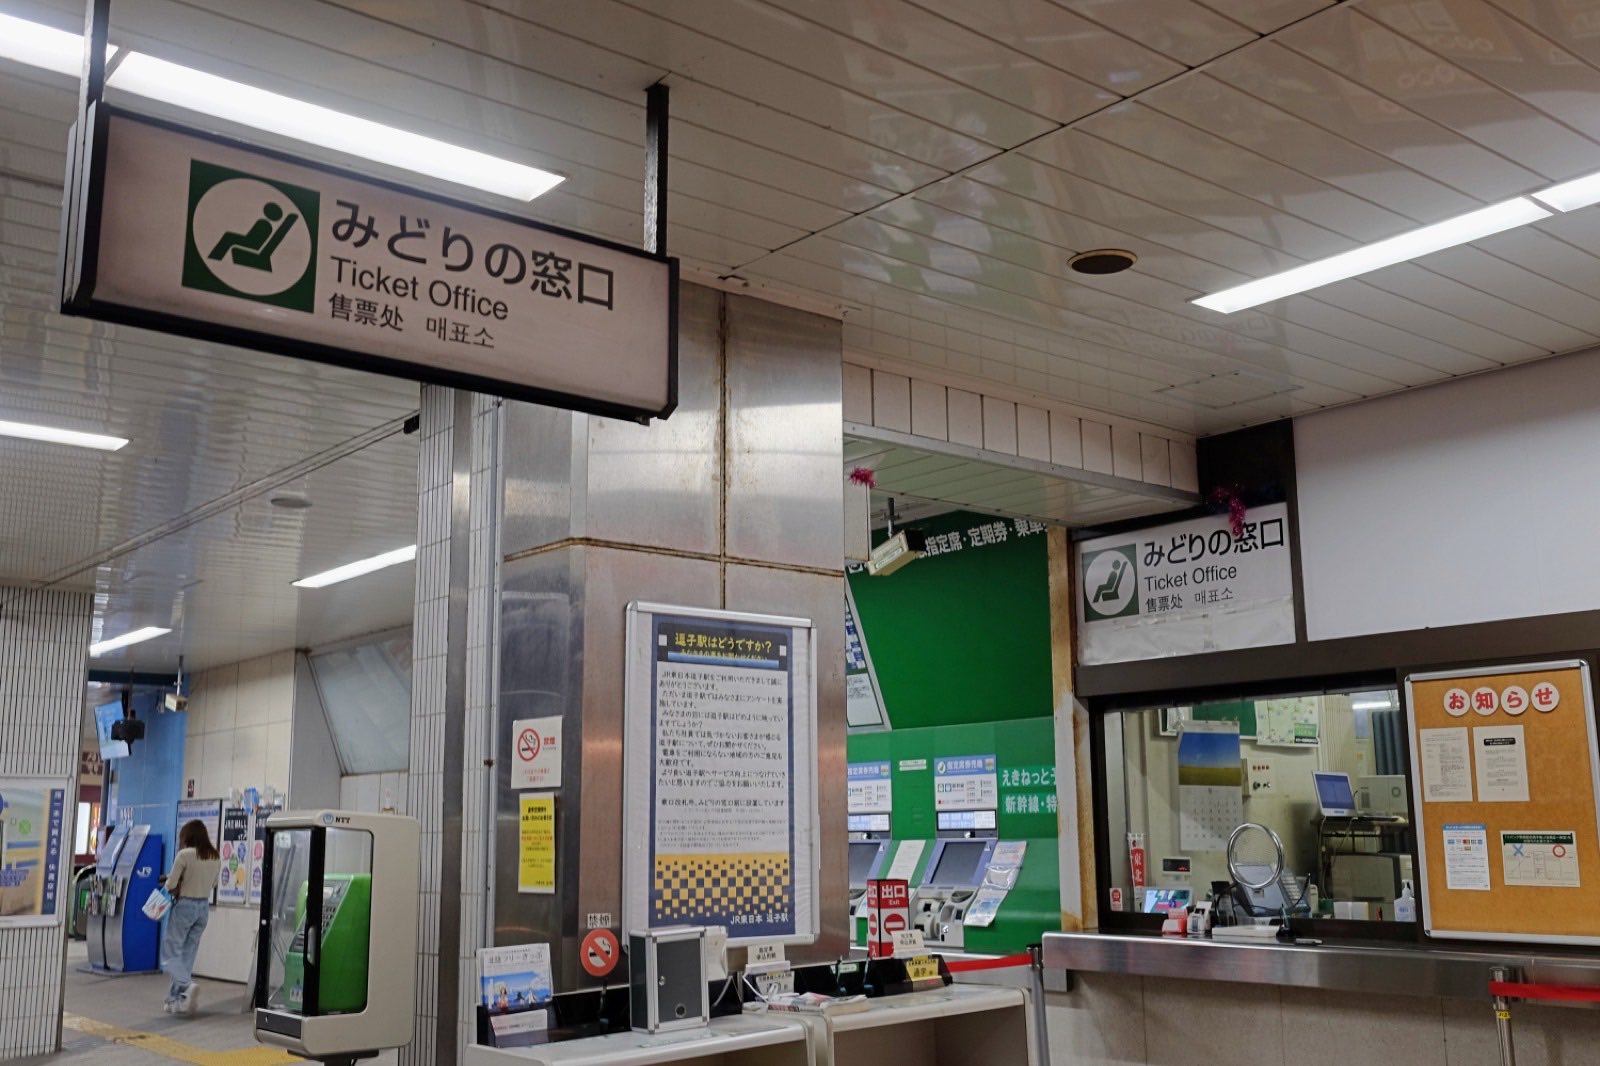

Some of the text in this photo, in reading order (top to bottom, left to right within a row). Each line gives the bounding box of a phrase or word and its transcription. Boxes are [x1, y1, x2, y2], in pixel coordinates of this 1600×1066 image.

[332, 200, 615, 311] みどりの窓口
[330, 255, 509, 321] Ticket Office
[329, 291, 404, 332] 售票处
[426, 316, 495, 349] 매표소
[1143, 517, 1284, 567] みどりの窓口
[1144, 565, 1237, 592] Ticket Office
[1145, 594, 1183, 613] 售票处
[1194, 587, 1234, 606] 매표소
[1449, 687, 1553, 710] お知らせ
[881, 884, 905, 899] 出口
